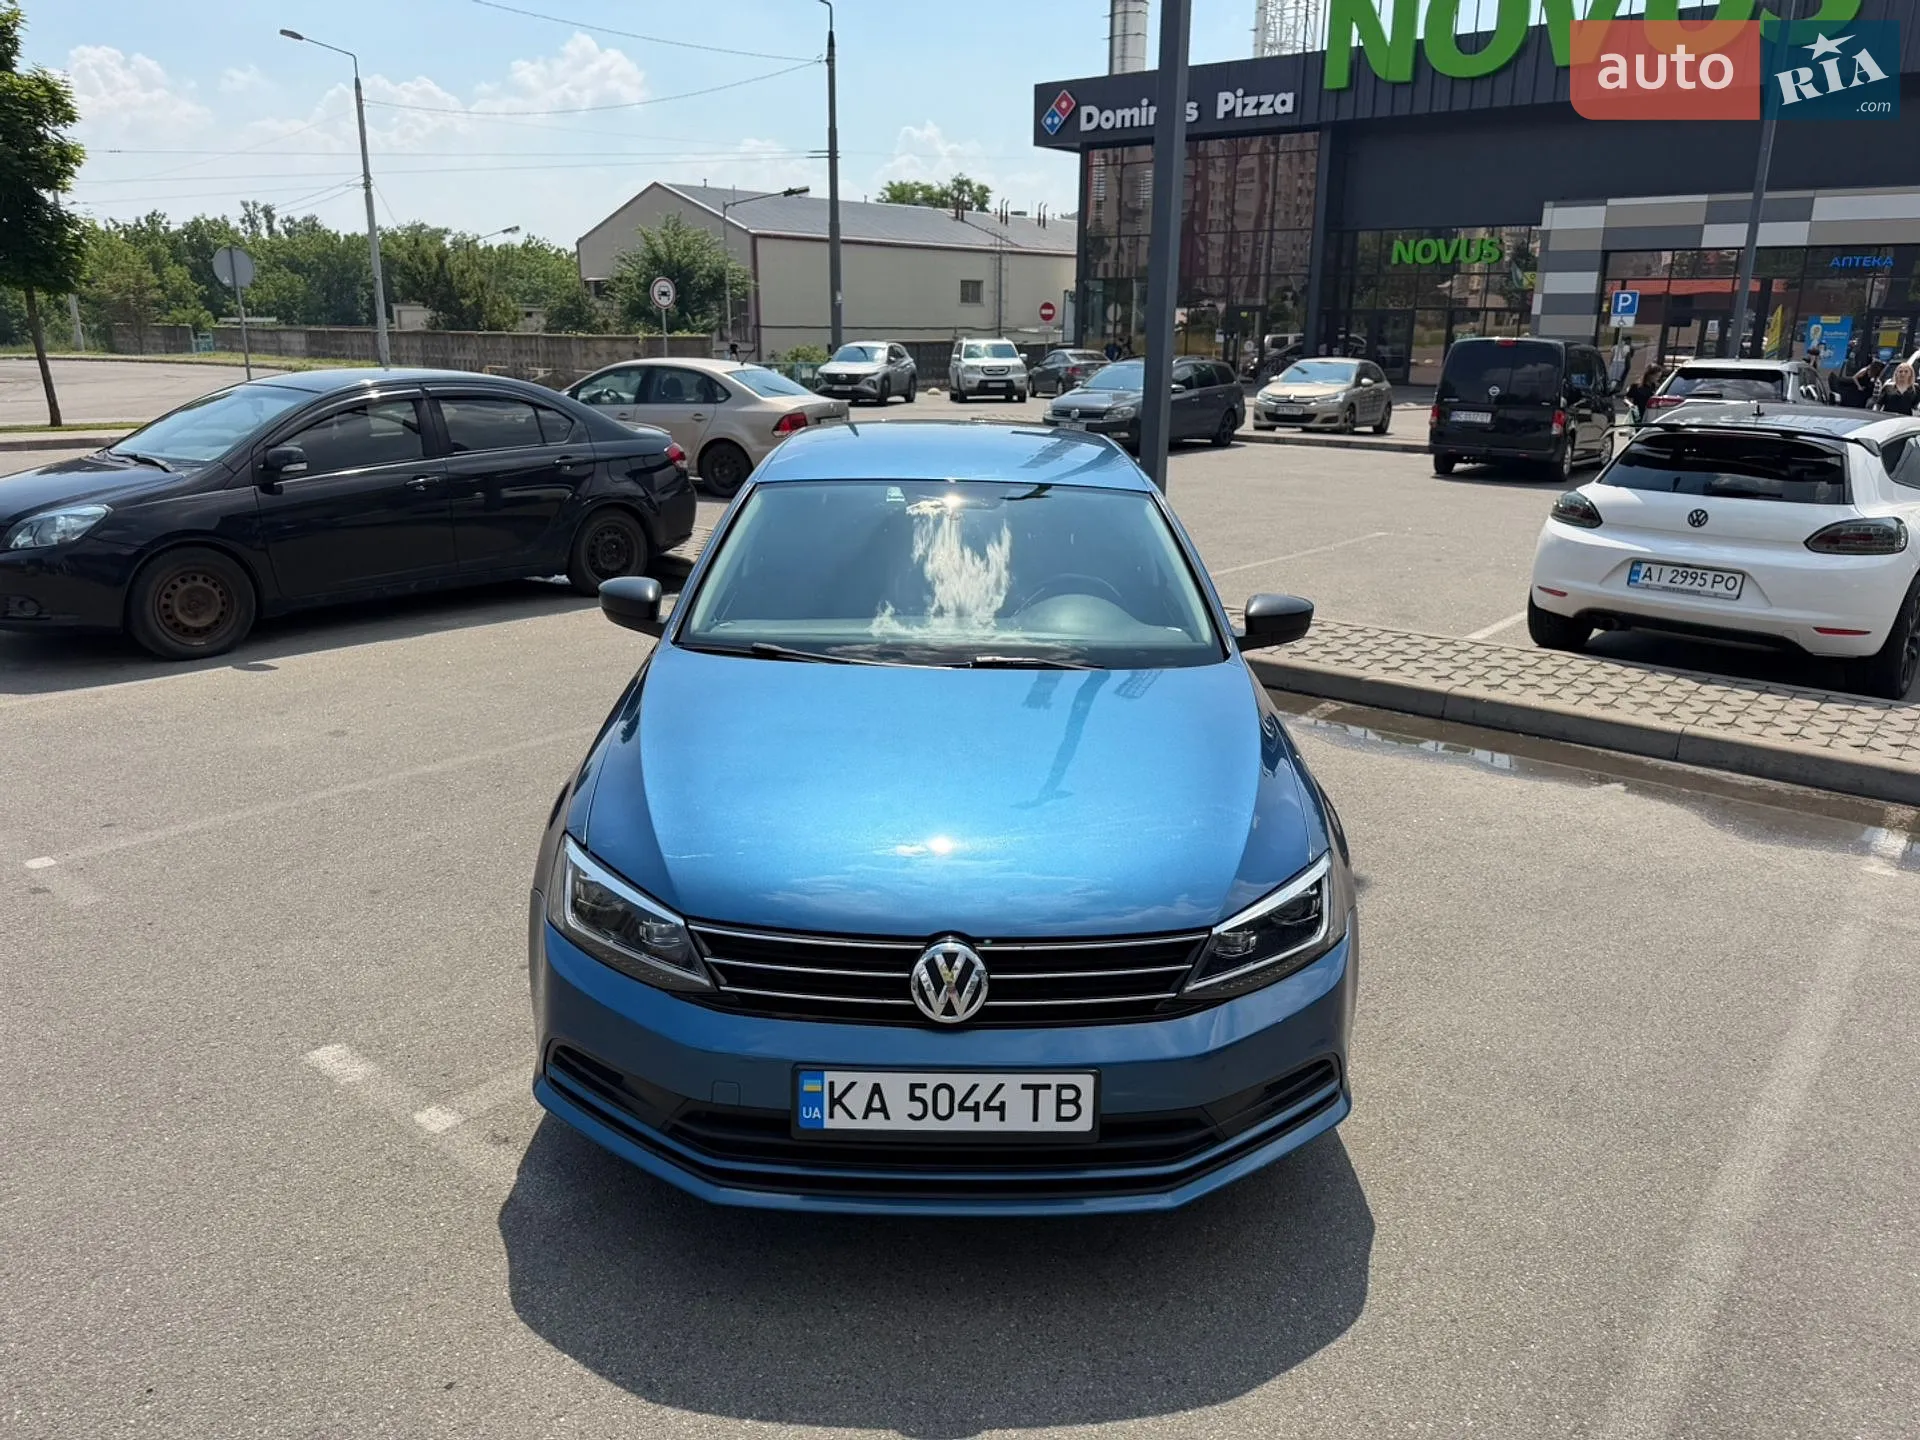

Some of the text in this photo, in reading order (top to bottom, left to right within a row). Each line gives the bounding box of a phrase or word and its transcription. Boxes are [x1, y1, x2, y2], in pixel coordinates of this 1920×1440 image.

[1079, 88, 1295, 132] Domins Pizza
[1391, 236, 1502, 265] NOVUS
[1829, 256, 1895, 268] АПТЕКА
[1617, 293, 1633, 313] P
[1641, 566, 1663, 583] AI
[1669, 569, 1709, 588] 2995
[1710, 574, 1738, 591] PO
[910, 942, 989, 1024] VW
[802, 1107, 822, 1120] UA
[828, 1081, 1083, 1123] KA 5044 TB
